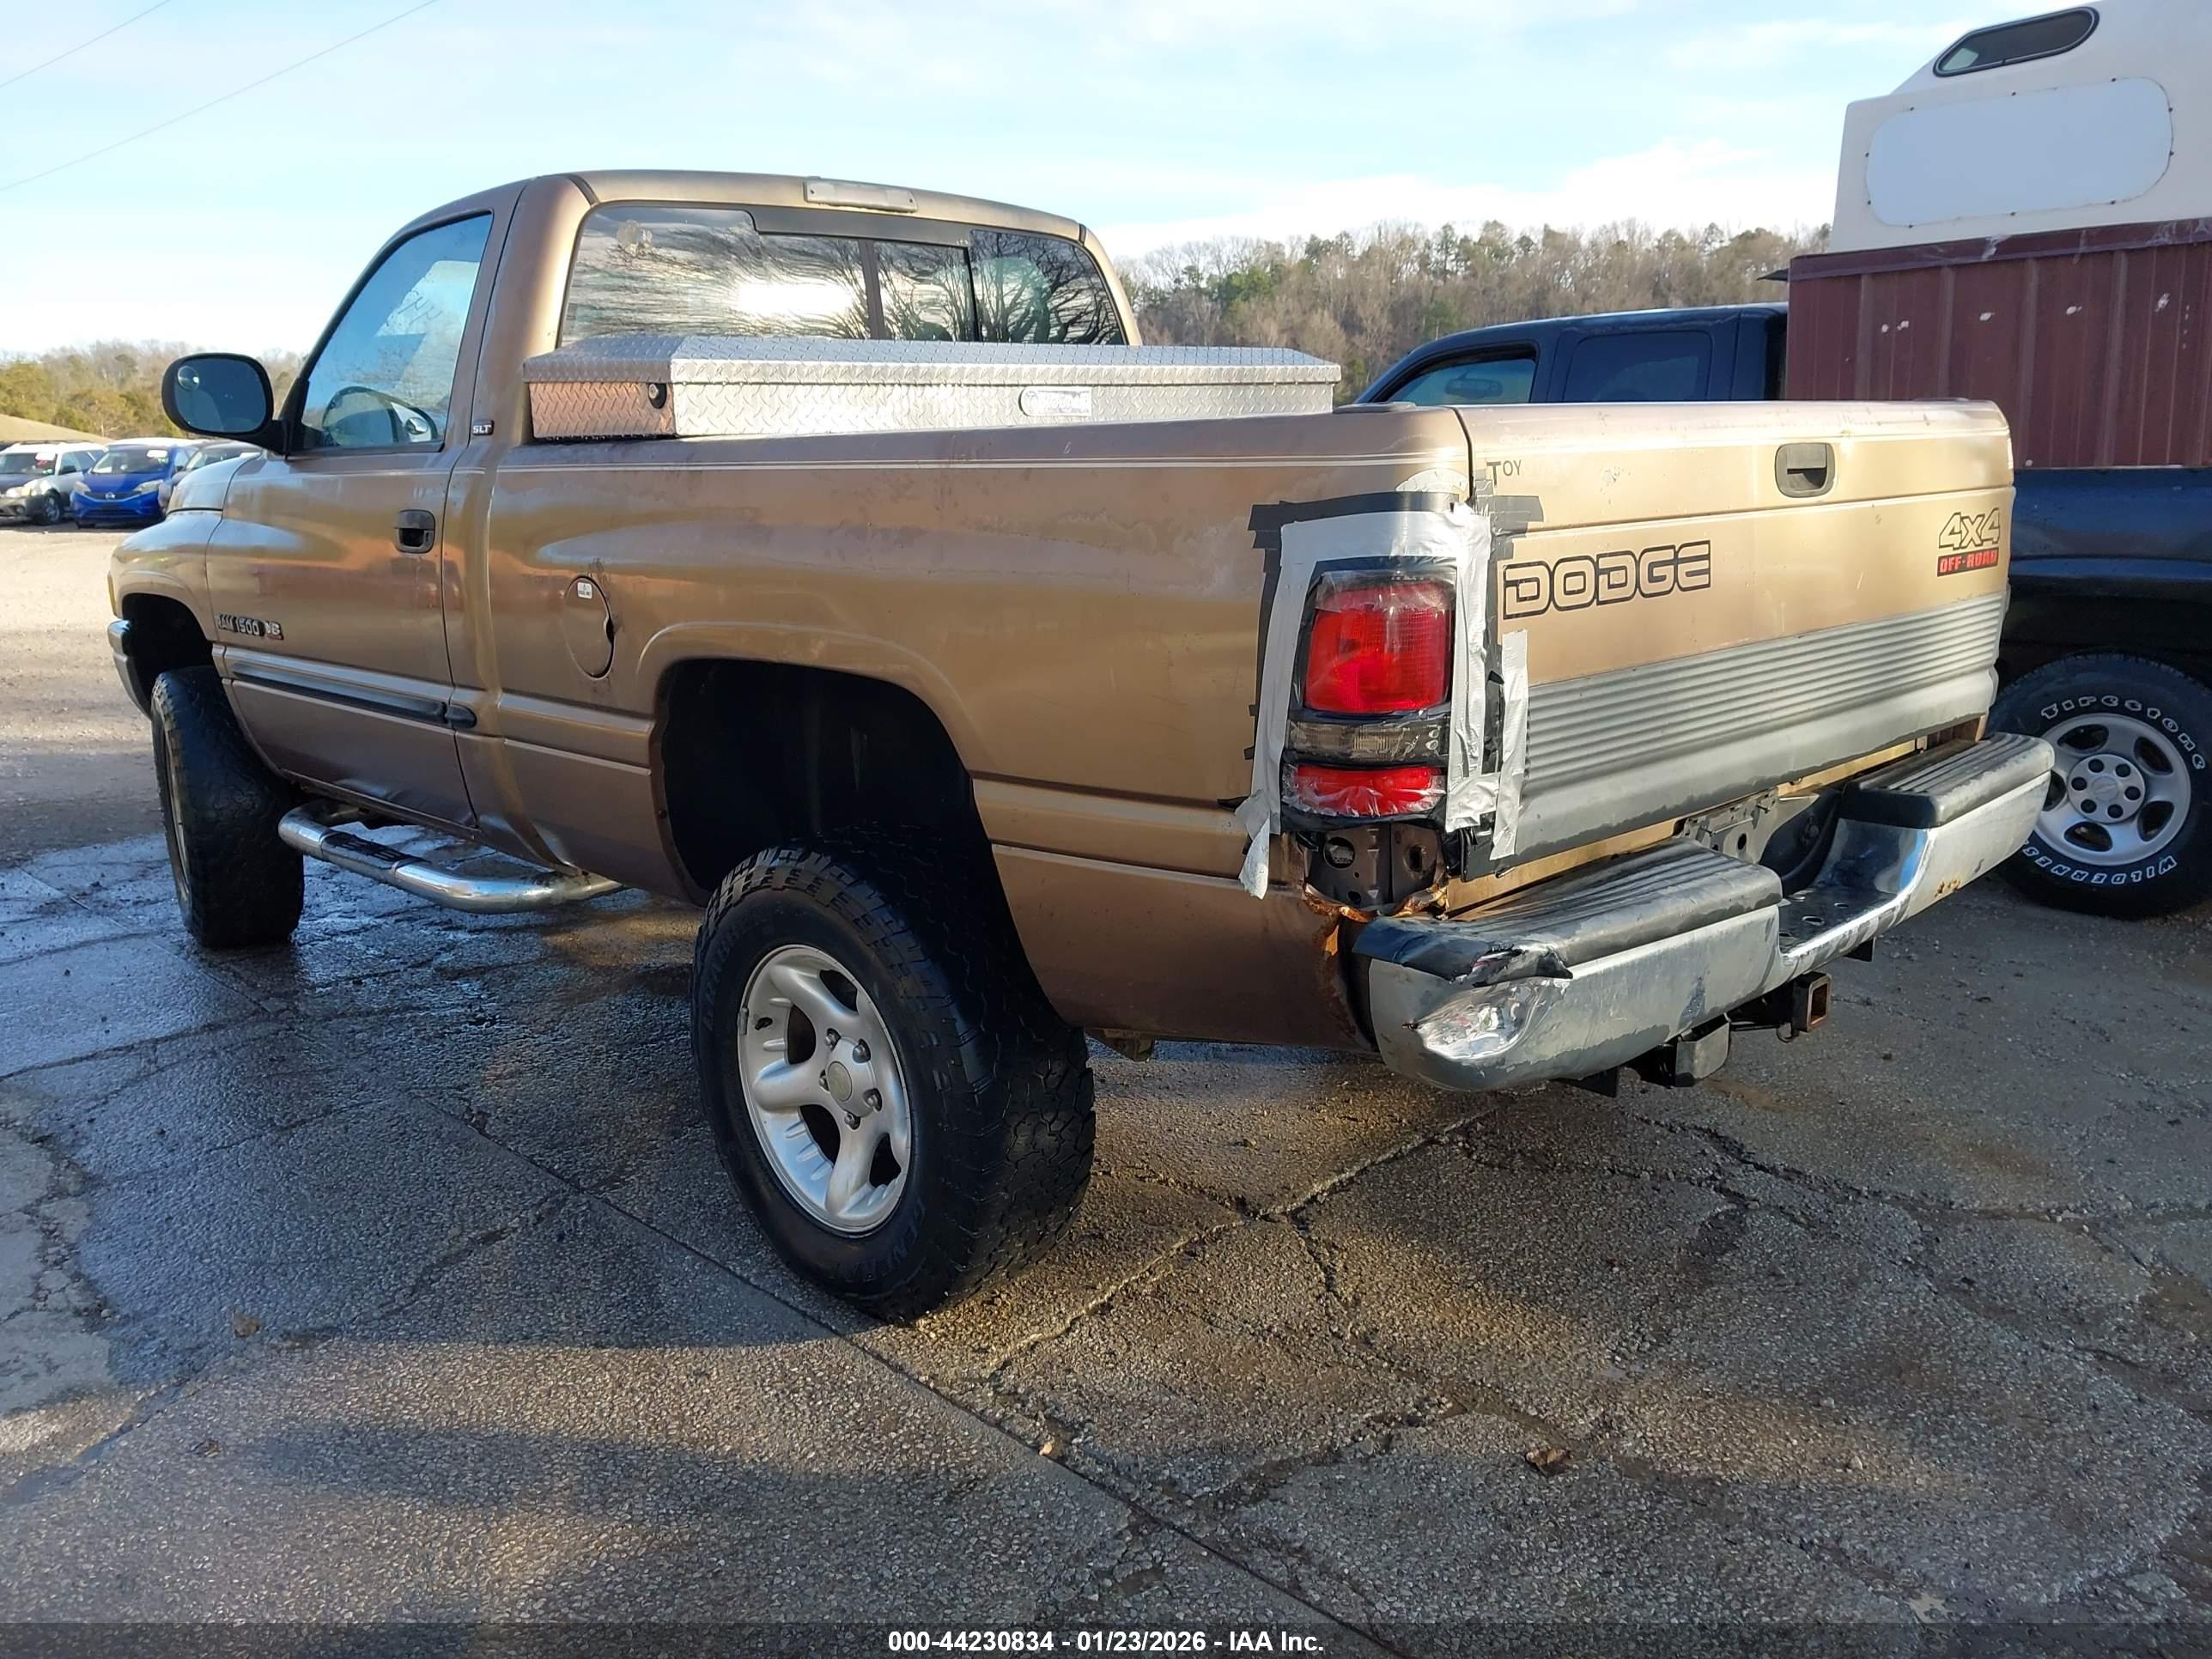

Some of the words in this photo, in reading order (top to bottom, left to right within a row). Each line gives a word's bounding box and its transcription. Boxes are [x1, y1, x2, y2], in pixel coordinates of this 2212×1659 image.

[471, 424, 492, 434] SLT
[1486, 459, 1522, 487] TOY
[1939, 549, 1998, 574] OFF-ROAD
[1503, 539, 1711, 621] DODGE
[235, 617, 261, 636] 1500
[2022, 840, 2178, 885] WILDERNES
